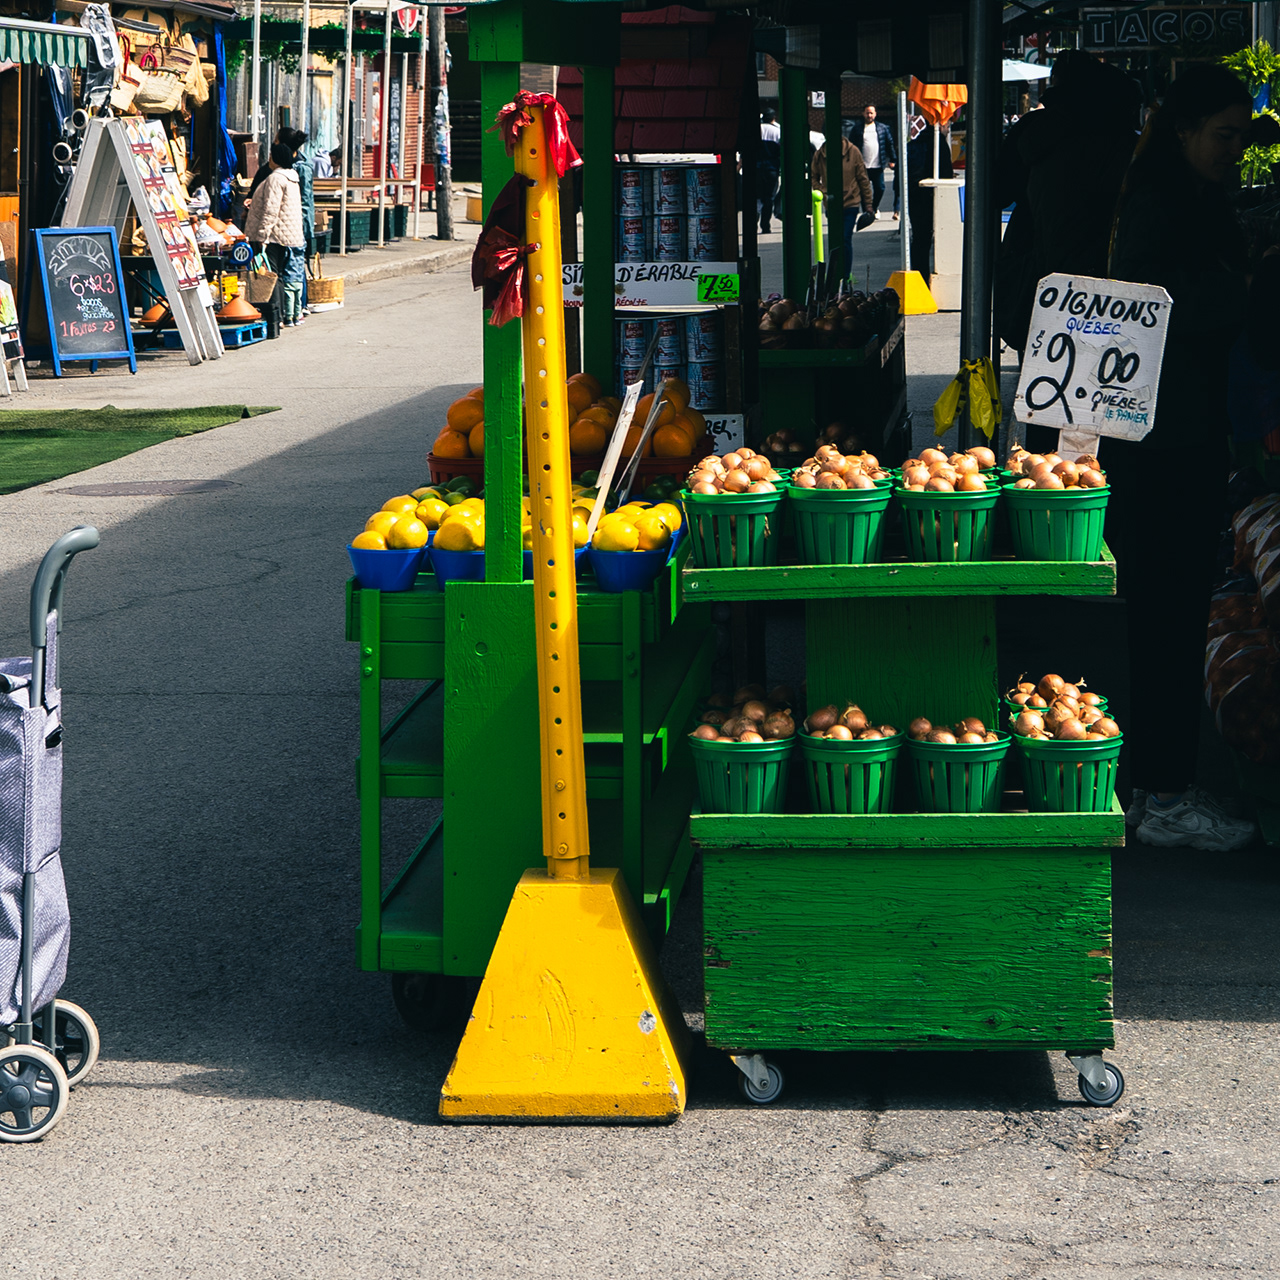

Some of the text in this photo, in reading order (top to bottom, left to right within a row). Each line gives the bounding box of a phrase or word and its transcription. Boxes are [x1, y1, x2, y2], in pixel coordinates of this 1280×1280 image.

[1085, 9, 1249, 44] TACOS
[616, 263, 702, 283] D'ÉRABLE
[1039, 281, 1160, 328] OIGNONS
[1066, 315, 1122, 335] QUÉBEC
[1091, 390, 1148, 412] QUÉBEC
